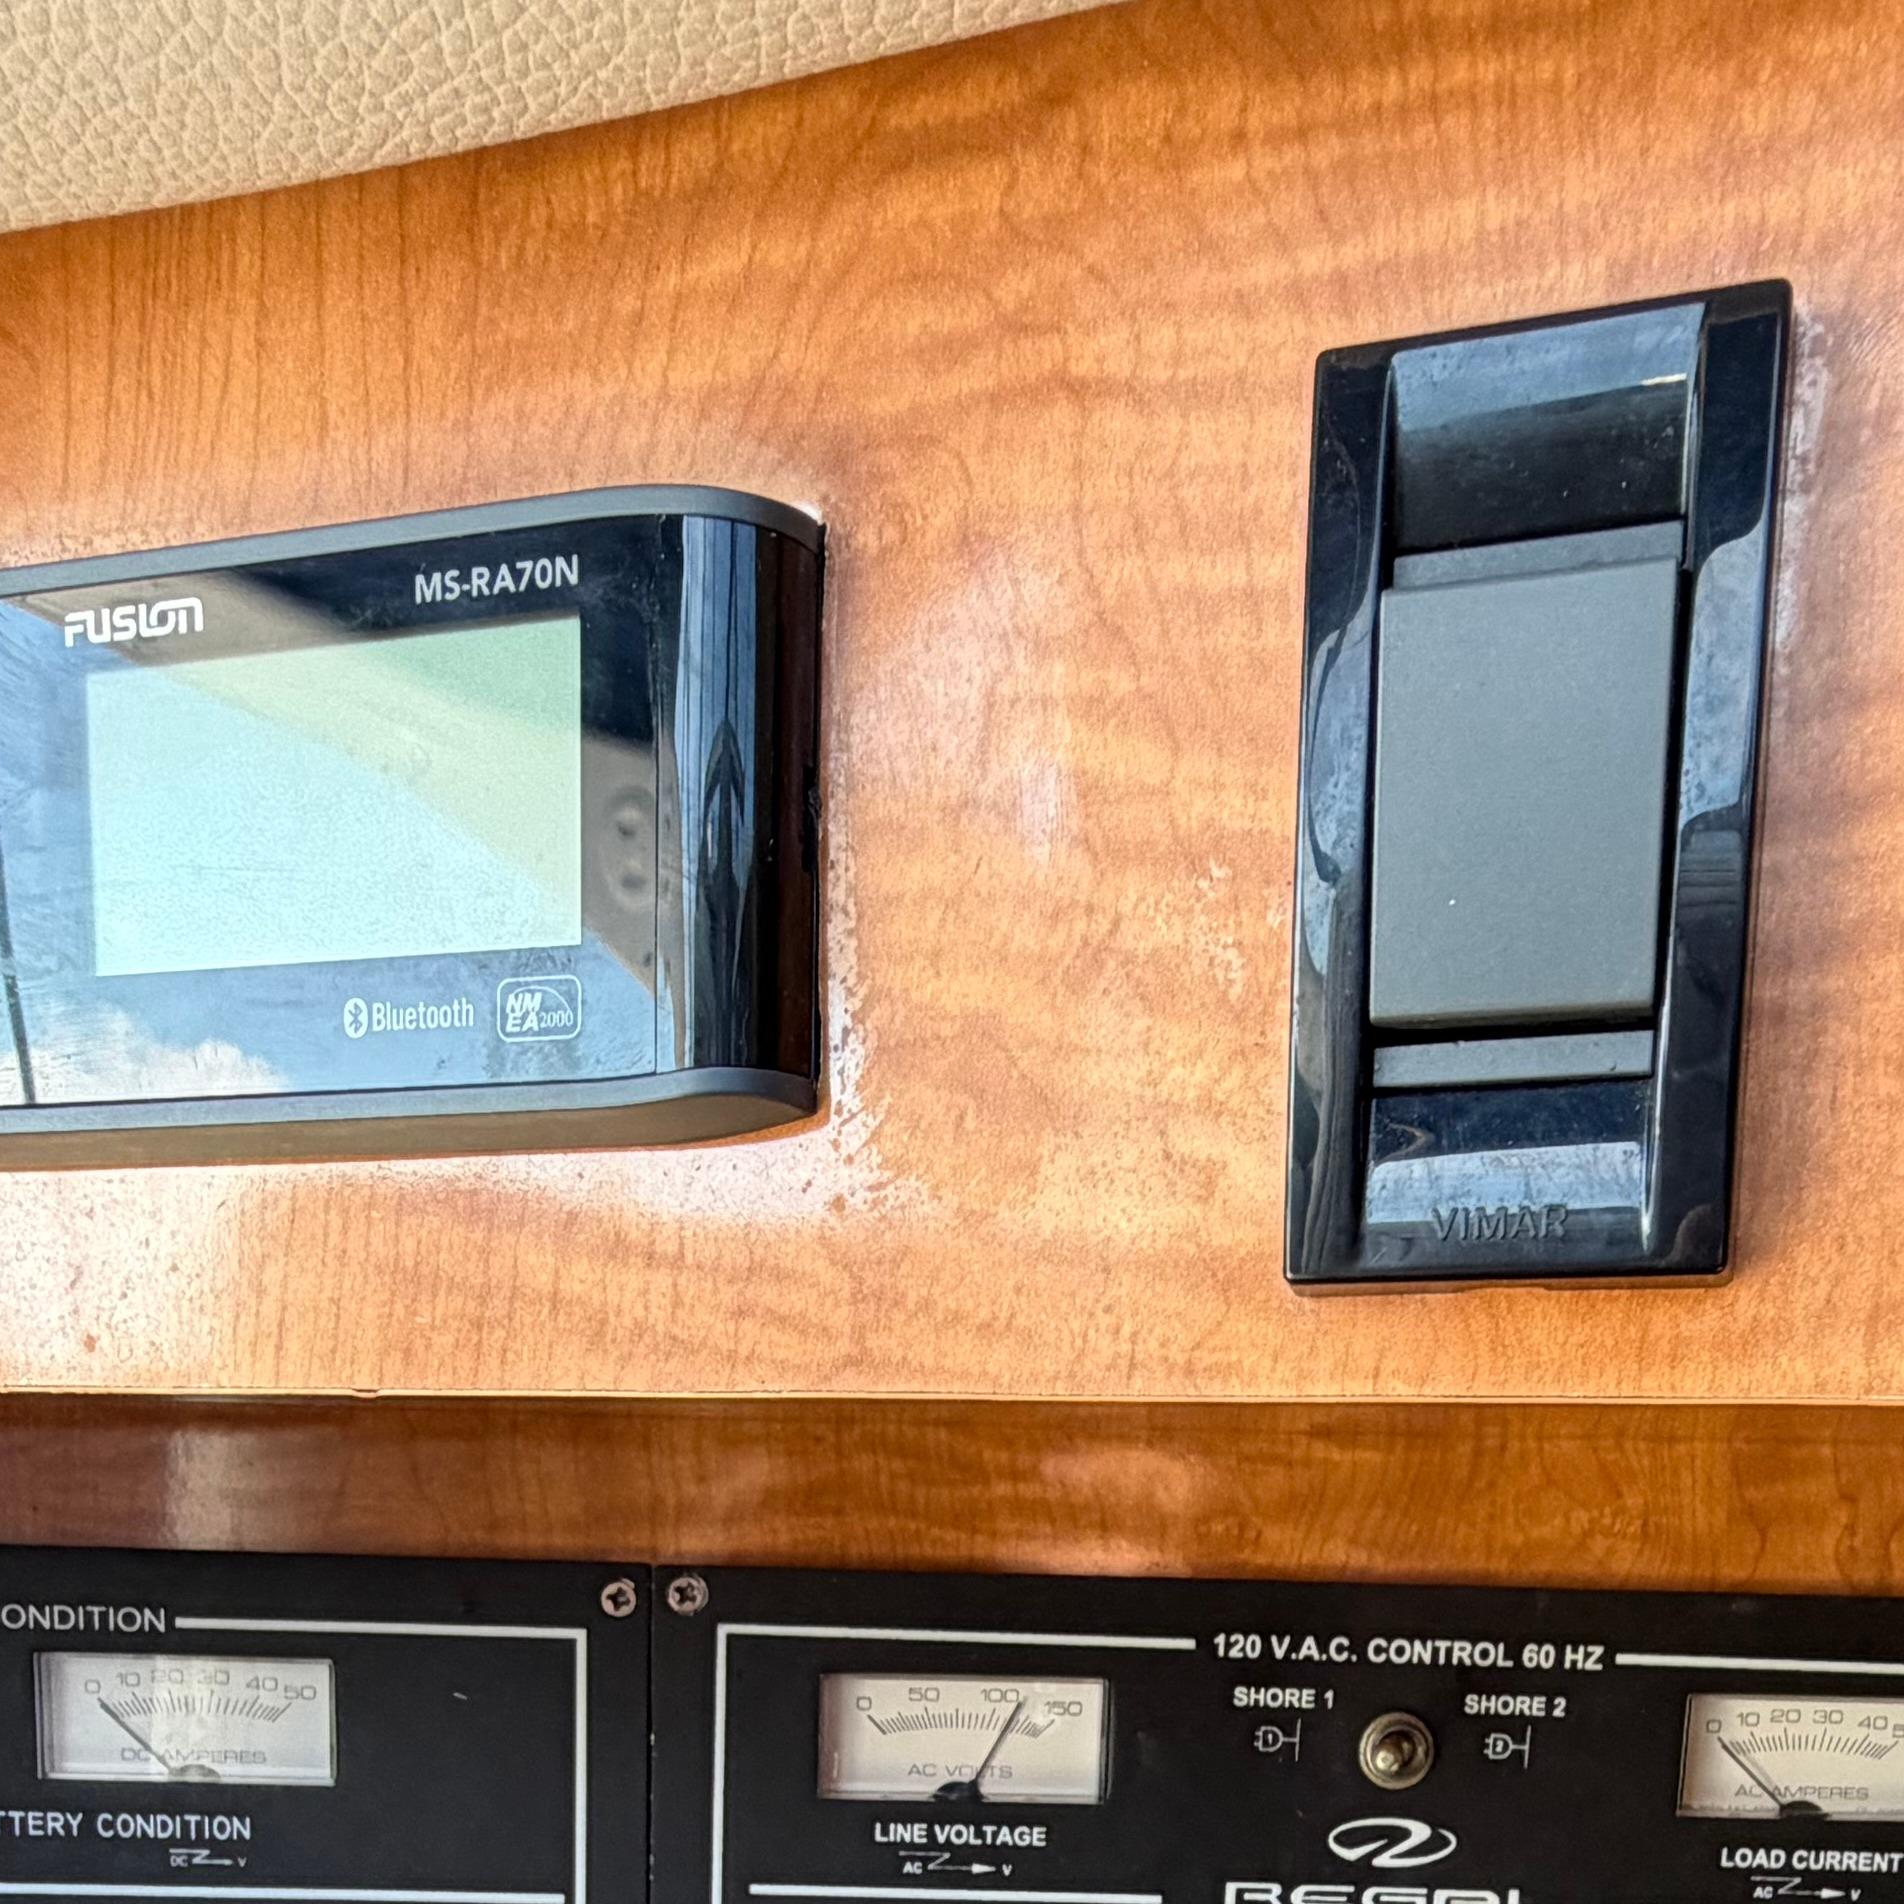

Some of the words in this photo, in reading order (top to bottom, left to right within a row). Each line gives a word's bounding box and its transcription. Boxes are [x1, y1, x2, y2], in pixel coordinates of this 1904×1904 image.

[414, 554, 580, 605] MS-RA70N
[64, 597, 204, 648] FUSION
[372, 997, 475, 1032] Bluetooth
[1431, 1203, 1570, 1242] VIMAR
[1212, 1633, 1262, 1659] 120
[1270, 1635, 1358, 1663] V.A.C.
[1366, 1640, 1514, 1668] CONTROL
[1522, 1643, 1556, 1669] 60
[1564, 1645, 1605, 1671] HZ
[84, 1679, 101, 1695] 0
[116, 1671, 141, 1688] 10
[246, 1675, 278, 1692] 40
[283, 1684, 317, 1701] 50
[1232, 1686, 1316, 1709] SHORE
[1324, 1690, 1335, 1710] 1
[856, 1696, 873, 1712] 0
[907, 1686, 941, 1703] 50
[979, 1687, 1020, 1704] 100
[1043, 1700, 1084, 1718] 150
[1464, 1694, 1548, 1717] SHORE
[1552, 1697, 1567, 1718] 2
[1705, 1718, 1722, 1735] 0
[1736, 1711, 1760, 1727] 10
[1769, 1708, 1802, 1725] 20
[1812, 1709, 1844, 1726] 30
[1857, 1715, 1889, 1731] 40
[162, 1749, 267, 1765] AMPERES
[907, 1763, 937, 1779] AC
[1771, 1785, 1870, 1801] AMPERES
[96, 1812, 251, 1841] CONDITION
[874, 1822, 928, 1844] LINE
[934, 1824, 1048, 1847] VOLTAGE
[902, 1860, 924, 1875] AC
[1720, 1846, 1786, 1870] LOAD
[1792, 1849, 1904, 1874] CURRENT
[1753, 1886, 1774, 1899] AC
